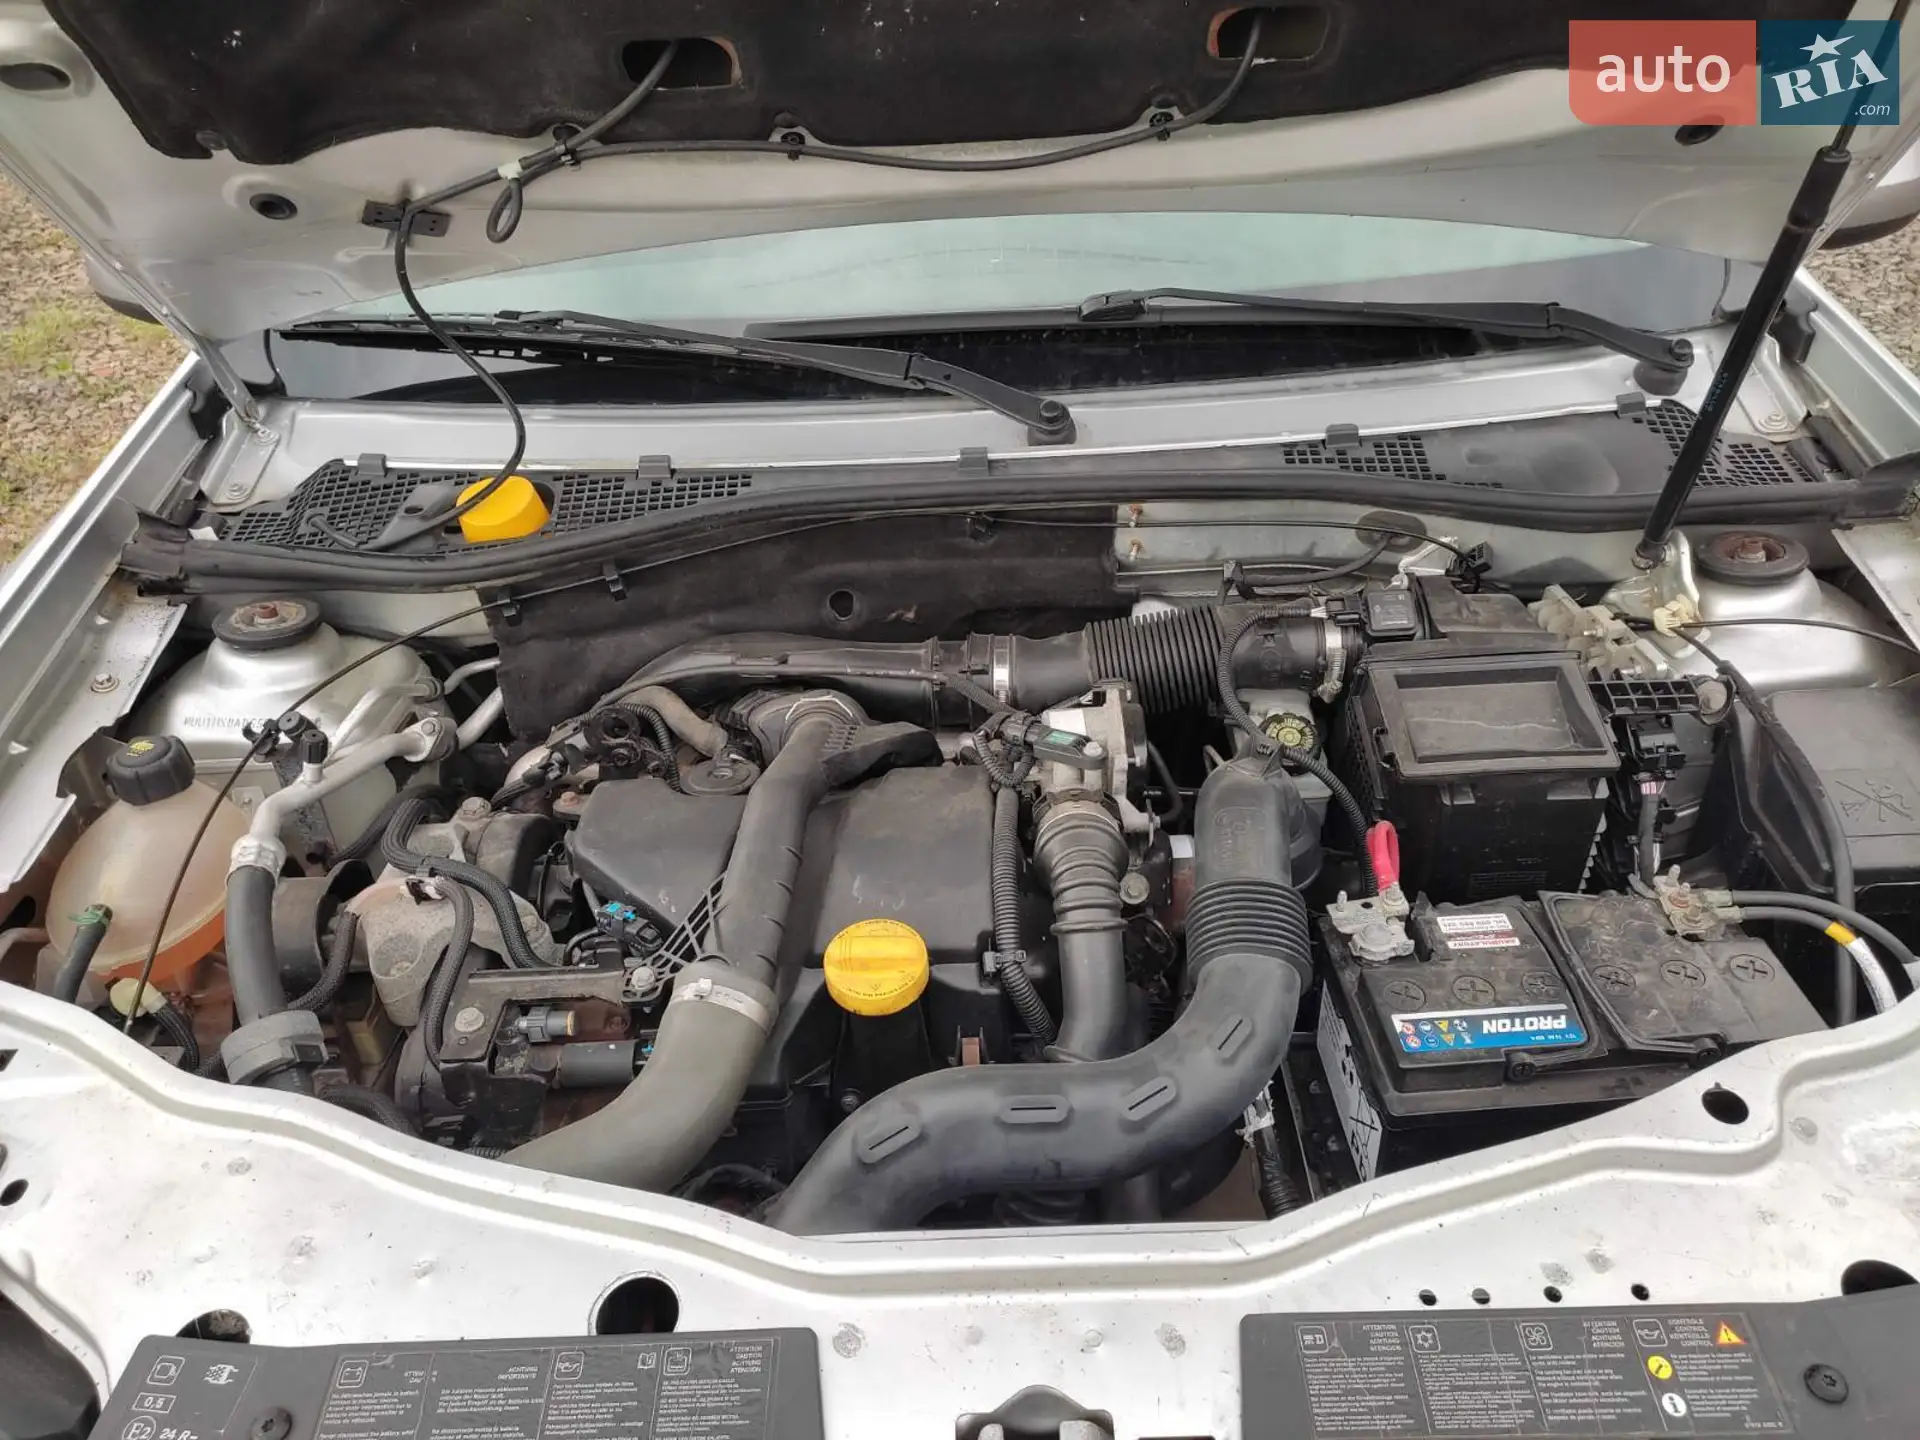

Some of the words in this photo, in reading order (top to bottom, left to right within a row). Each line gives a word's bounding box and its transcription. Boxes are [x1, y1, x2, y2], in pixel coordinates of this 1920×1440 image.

[1482, 1015, 1567, 1034] PROTON
[144, 1396, 166, 1409] 0,5
[159, 1428, 178, 1440] 24
